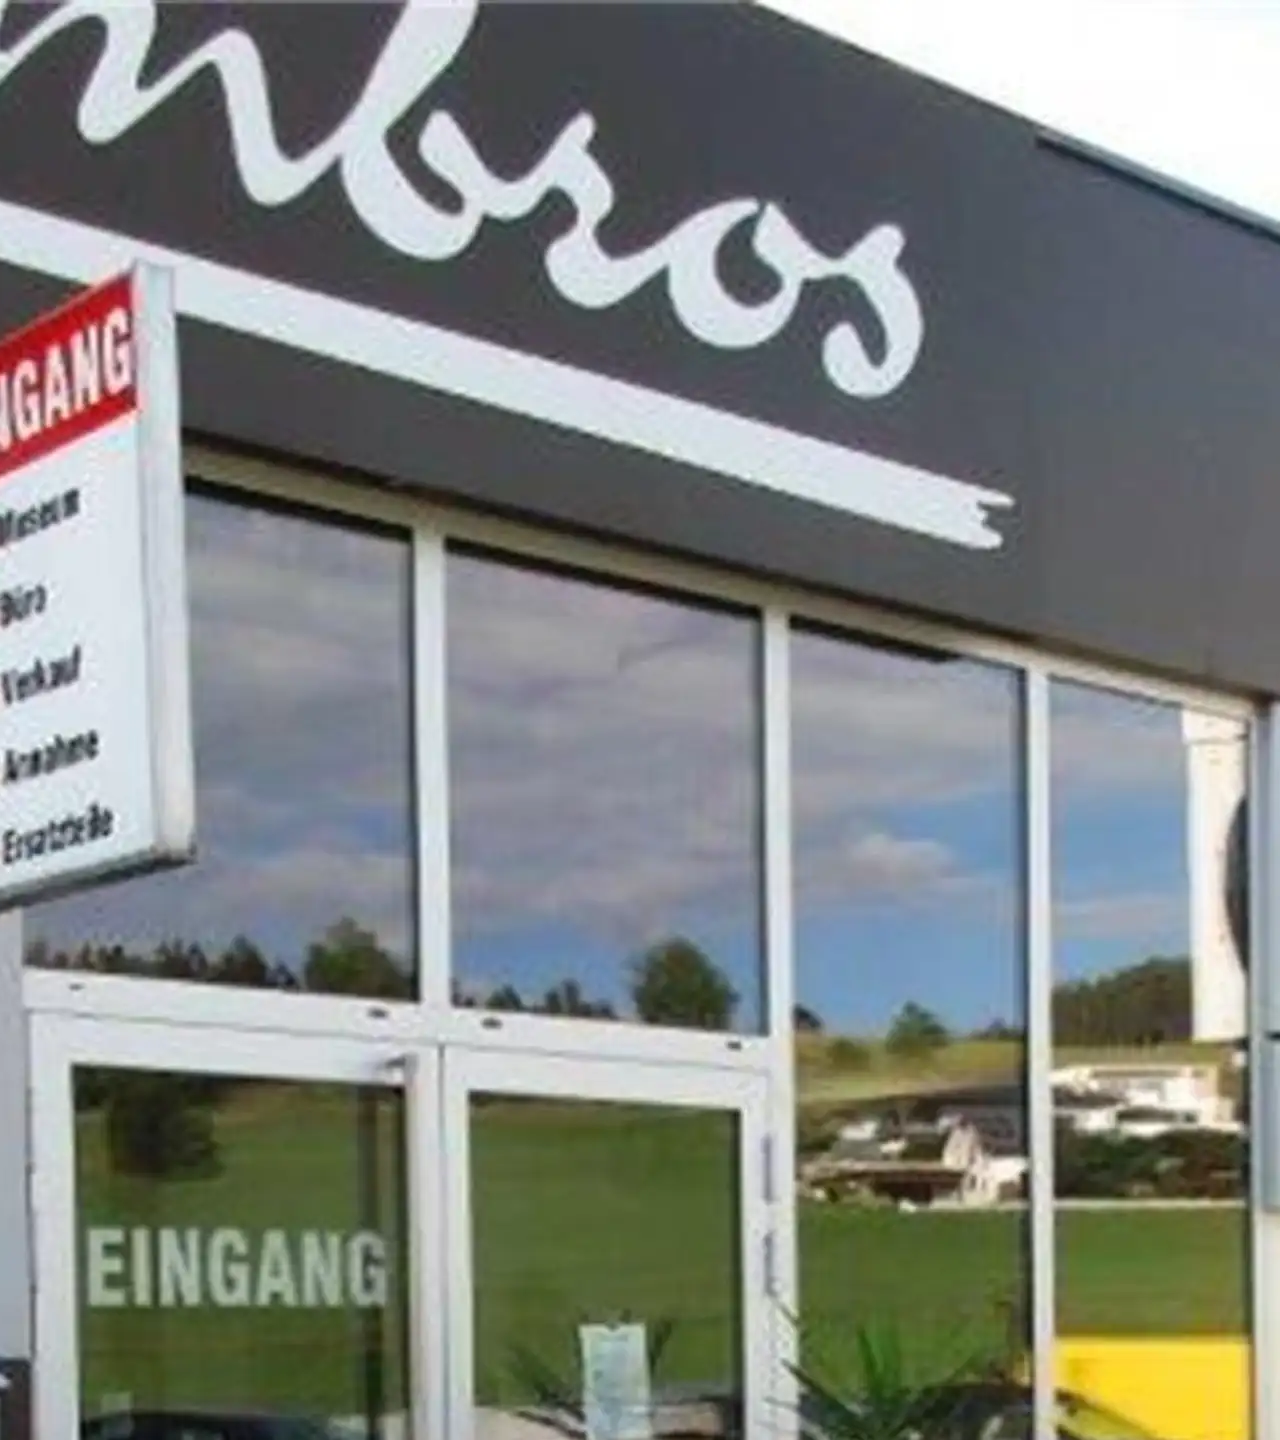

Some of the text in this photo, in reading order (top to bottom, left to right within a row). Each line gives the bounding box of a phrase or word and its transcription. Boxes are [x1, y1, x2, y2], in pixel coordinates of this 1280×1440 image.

[0, 643, 82, 707] Verkauf
[2, 729, 100, 786] Annahme
[2, 802, 114, 867] Ersatzteile
[87, 1226, 389, 1309] EINGANG
